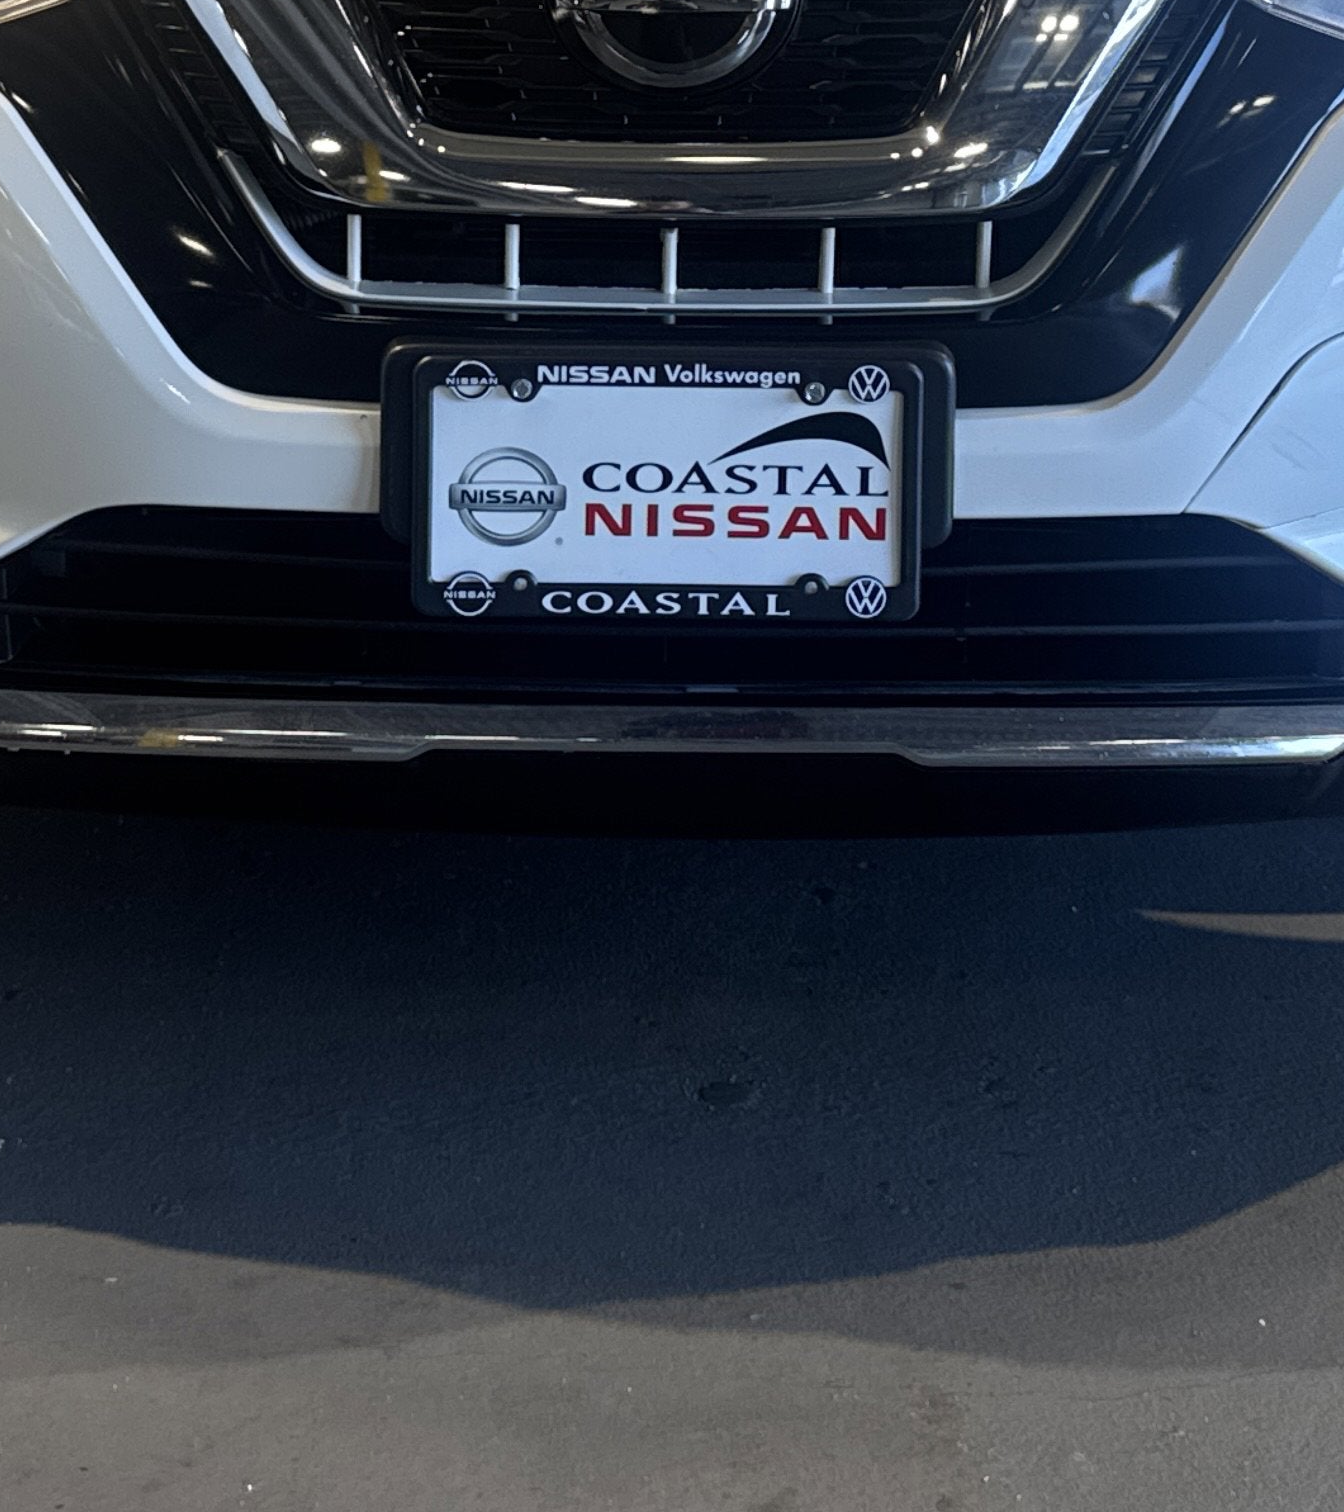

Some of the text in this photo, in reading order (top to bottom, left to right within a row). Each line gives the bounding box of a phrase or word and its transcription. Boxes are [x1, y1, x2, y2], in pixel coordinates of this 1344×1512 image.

[445, 377, 498, 385] NISSAN
[537, 364, 801, 387] NISSAN Volkswagen
[582, 461, 890, 497] COASTAL
[460, 489, 555, 505] NISSAN
[584, 502, 887, 540] NISSAN
[443, 590, 496, 599] NISSAN
[542, 590, 791, 616] COASTAL
